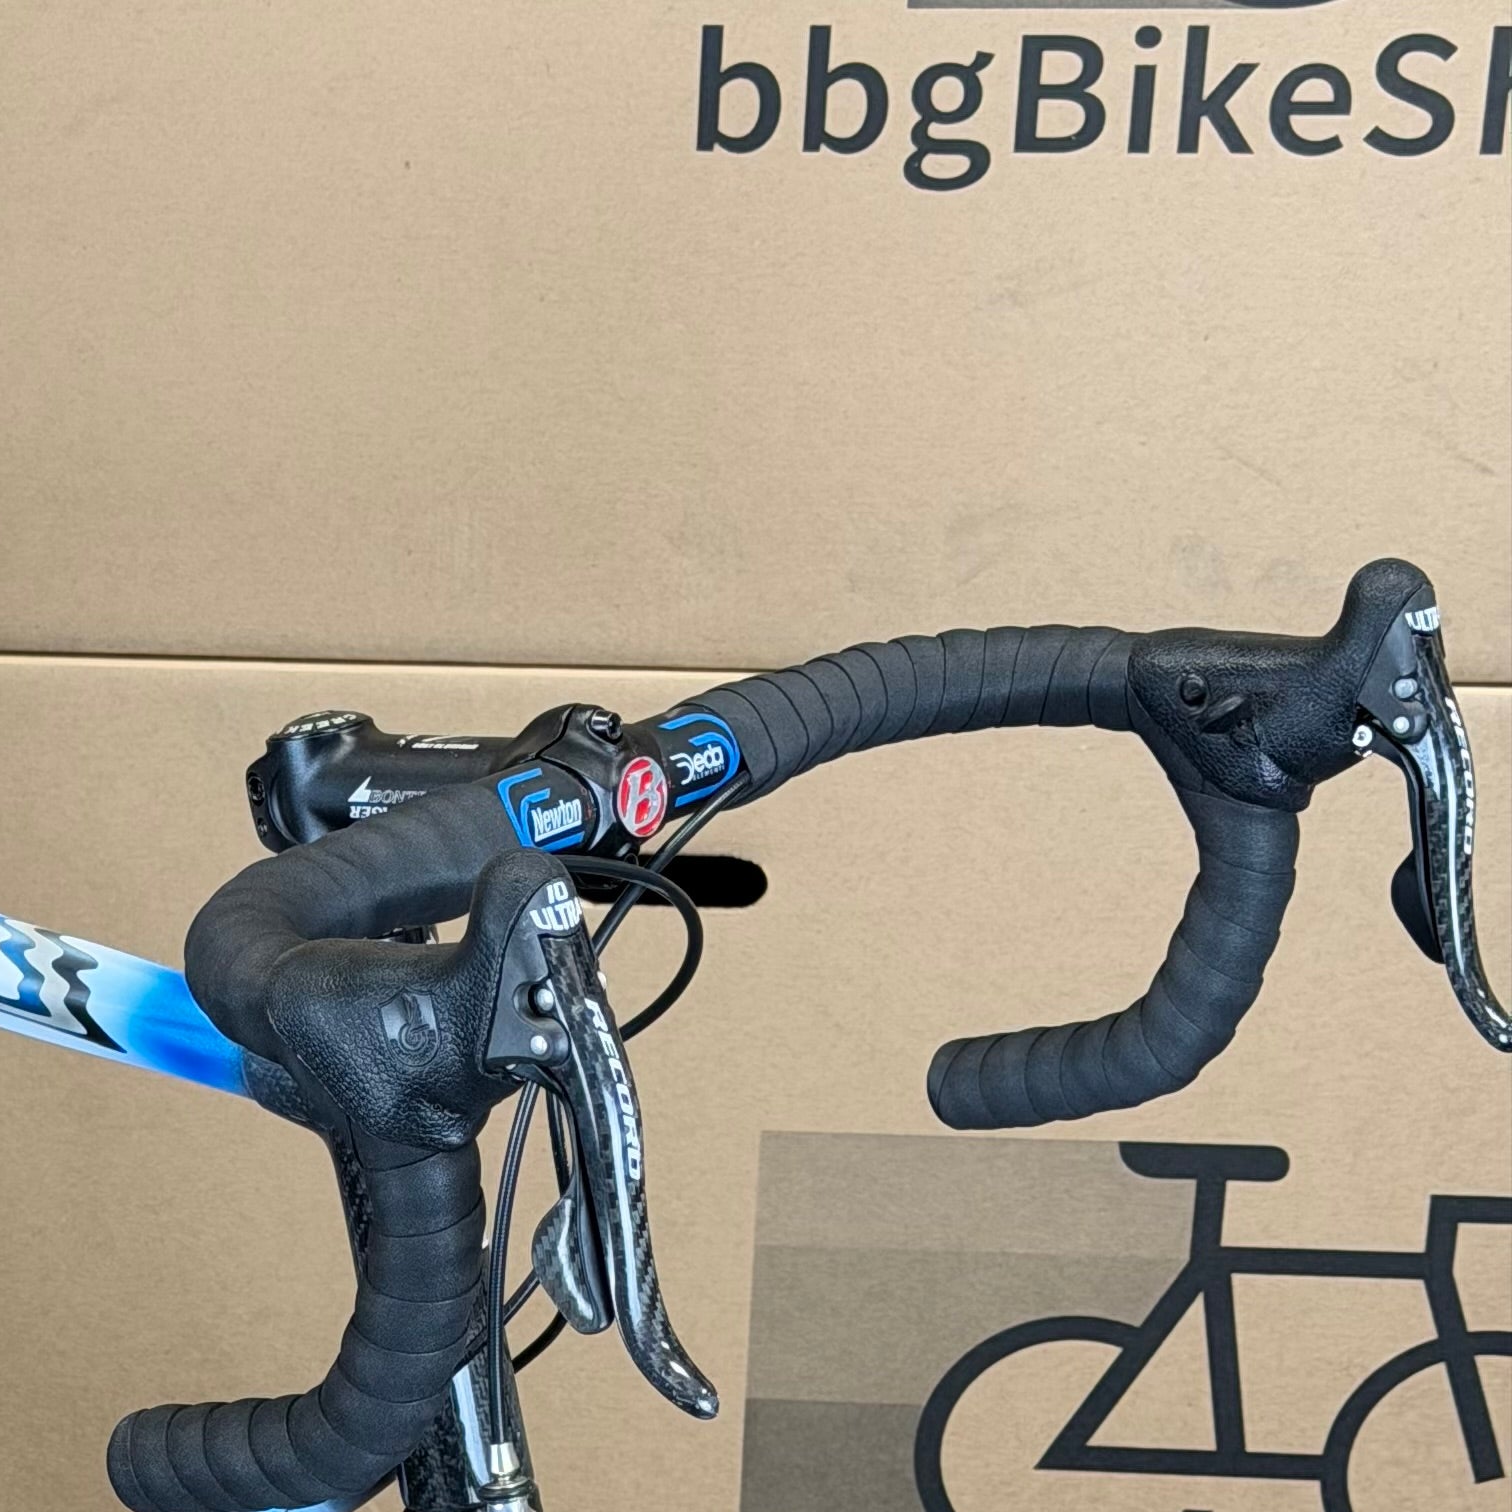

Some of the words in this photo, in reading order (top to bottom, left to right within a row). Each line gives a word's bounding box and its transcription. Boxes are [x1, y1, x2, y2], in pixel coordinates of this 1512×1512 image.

[670, 744, 724, 786] Deda
[530, 798, 582, 835] Newton
[584, 998, 643, 1181] RECORD
